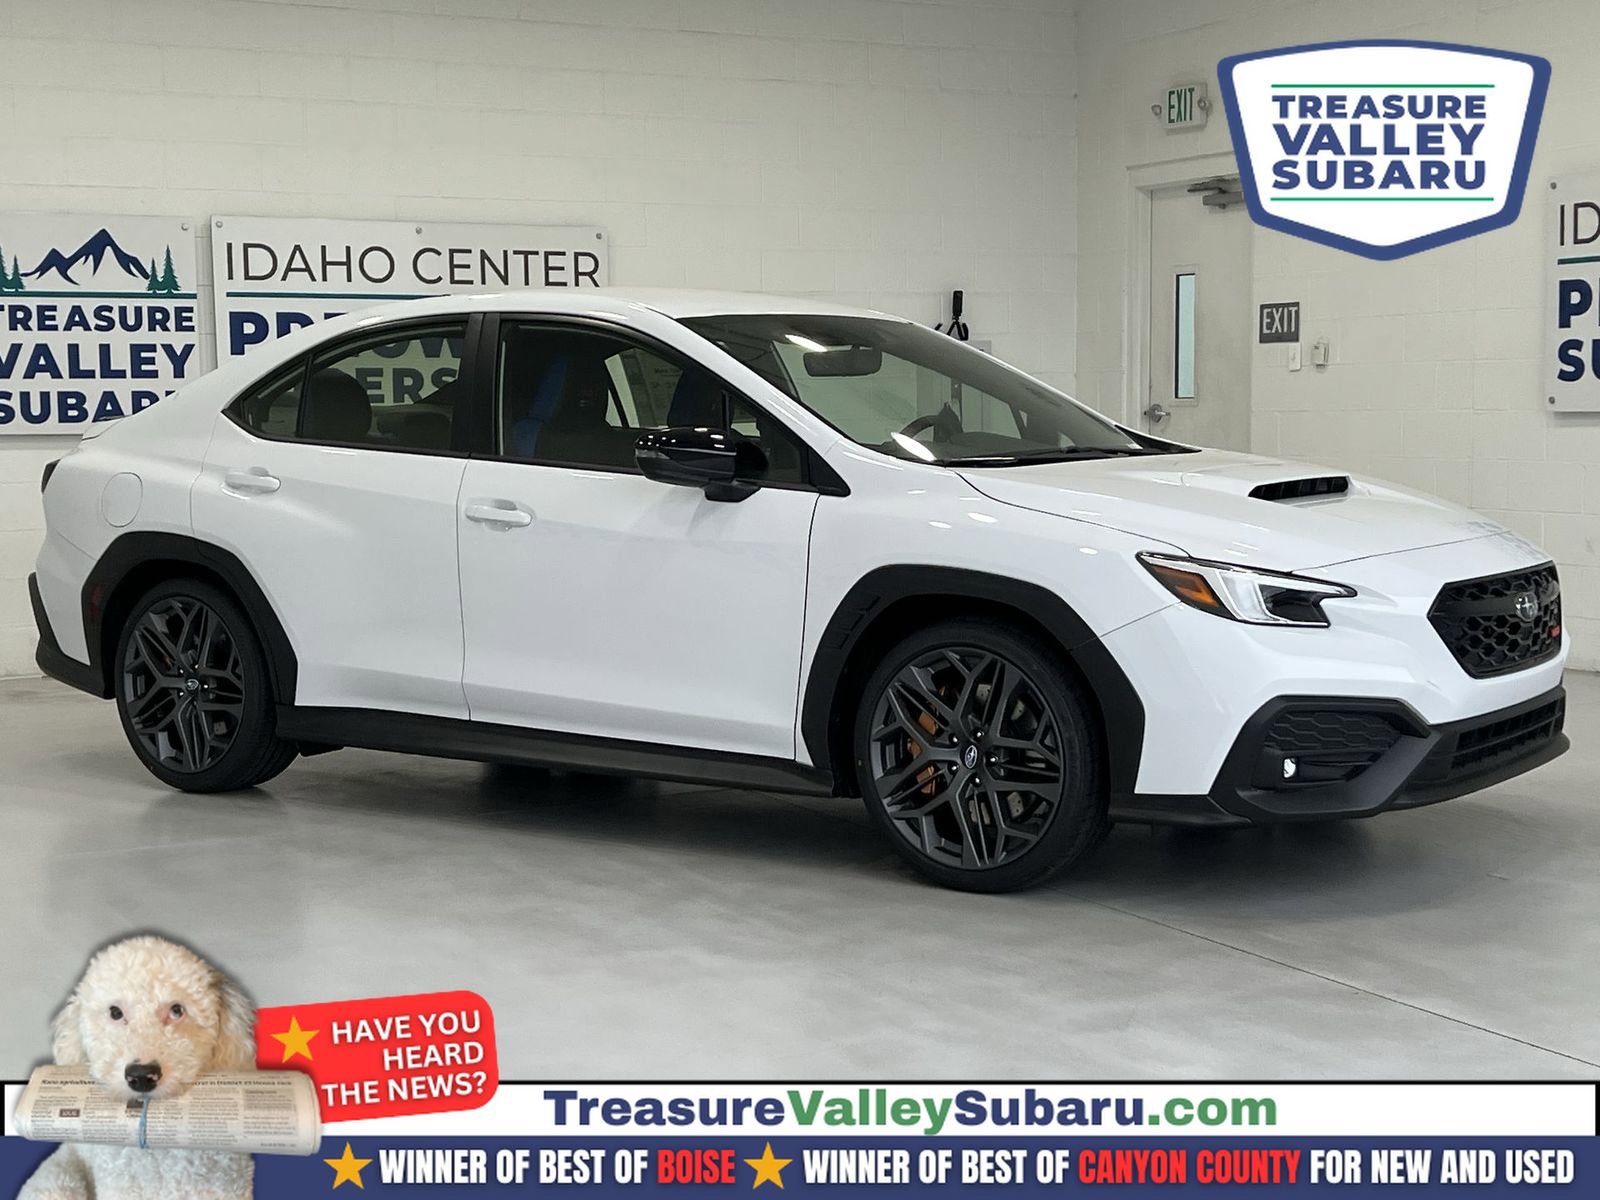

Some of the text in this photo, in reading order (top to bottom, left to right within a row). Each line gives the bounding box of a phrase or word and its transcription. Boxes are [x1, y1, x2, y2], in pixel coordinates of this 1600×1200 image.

[1167, 87, 1195, 123] EXIT
[226, 242, 600, 288] IDAHO CENTER
[1262, 306, 1298, 334] EXIT
[0, 343, 195, 379] VALLEY
